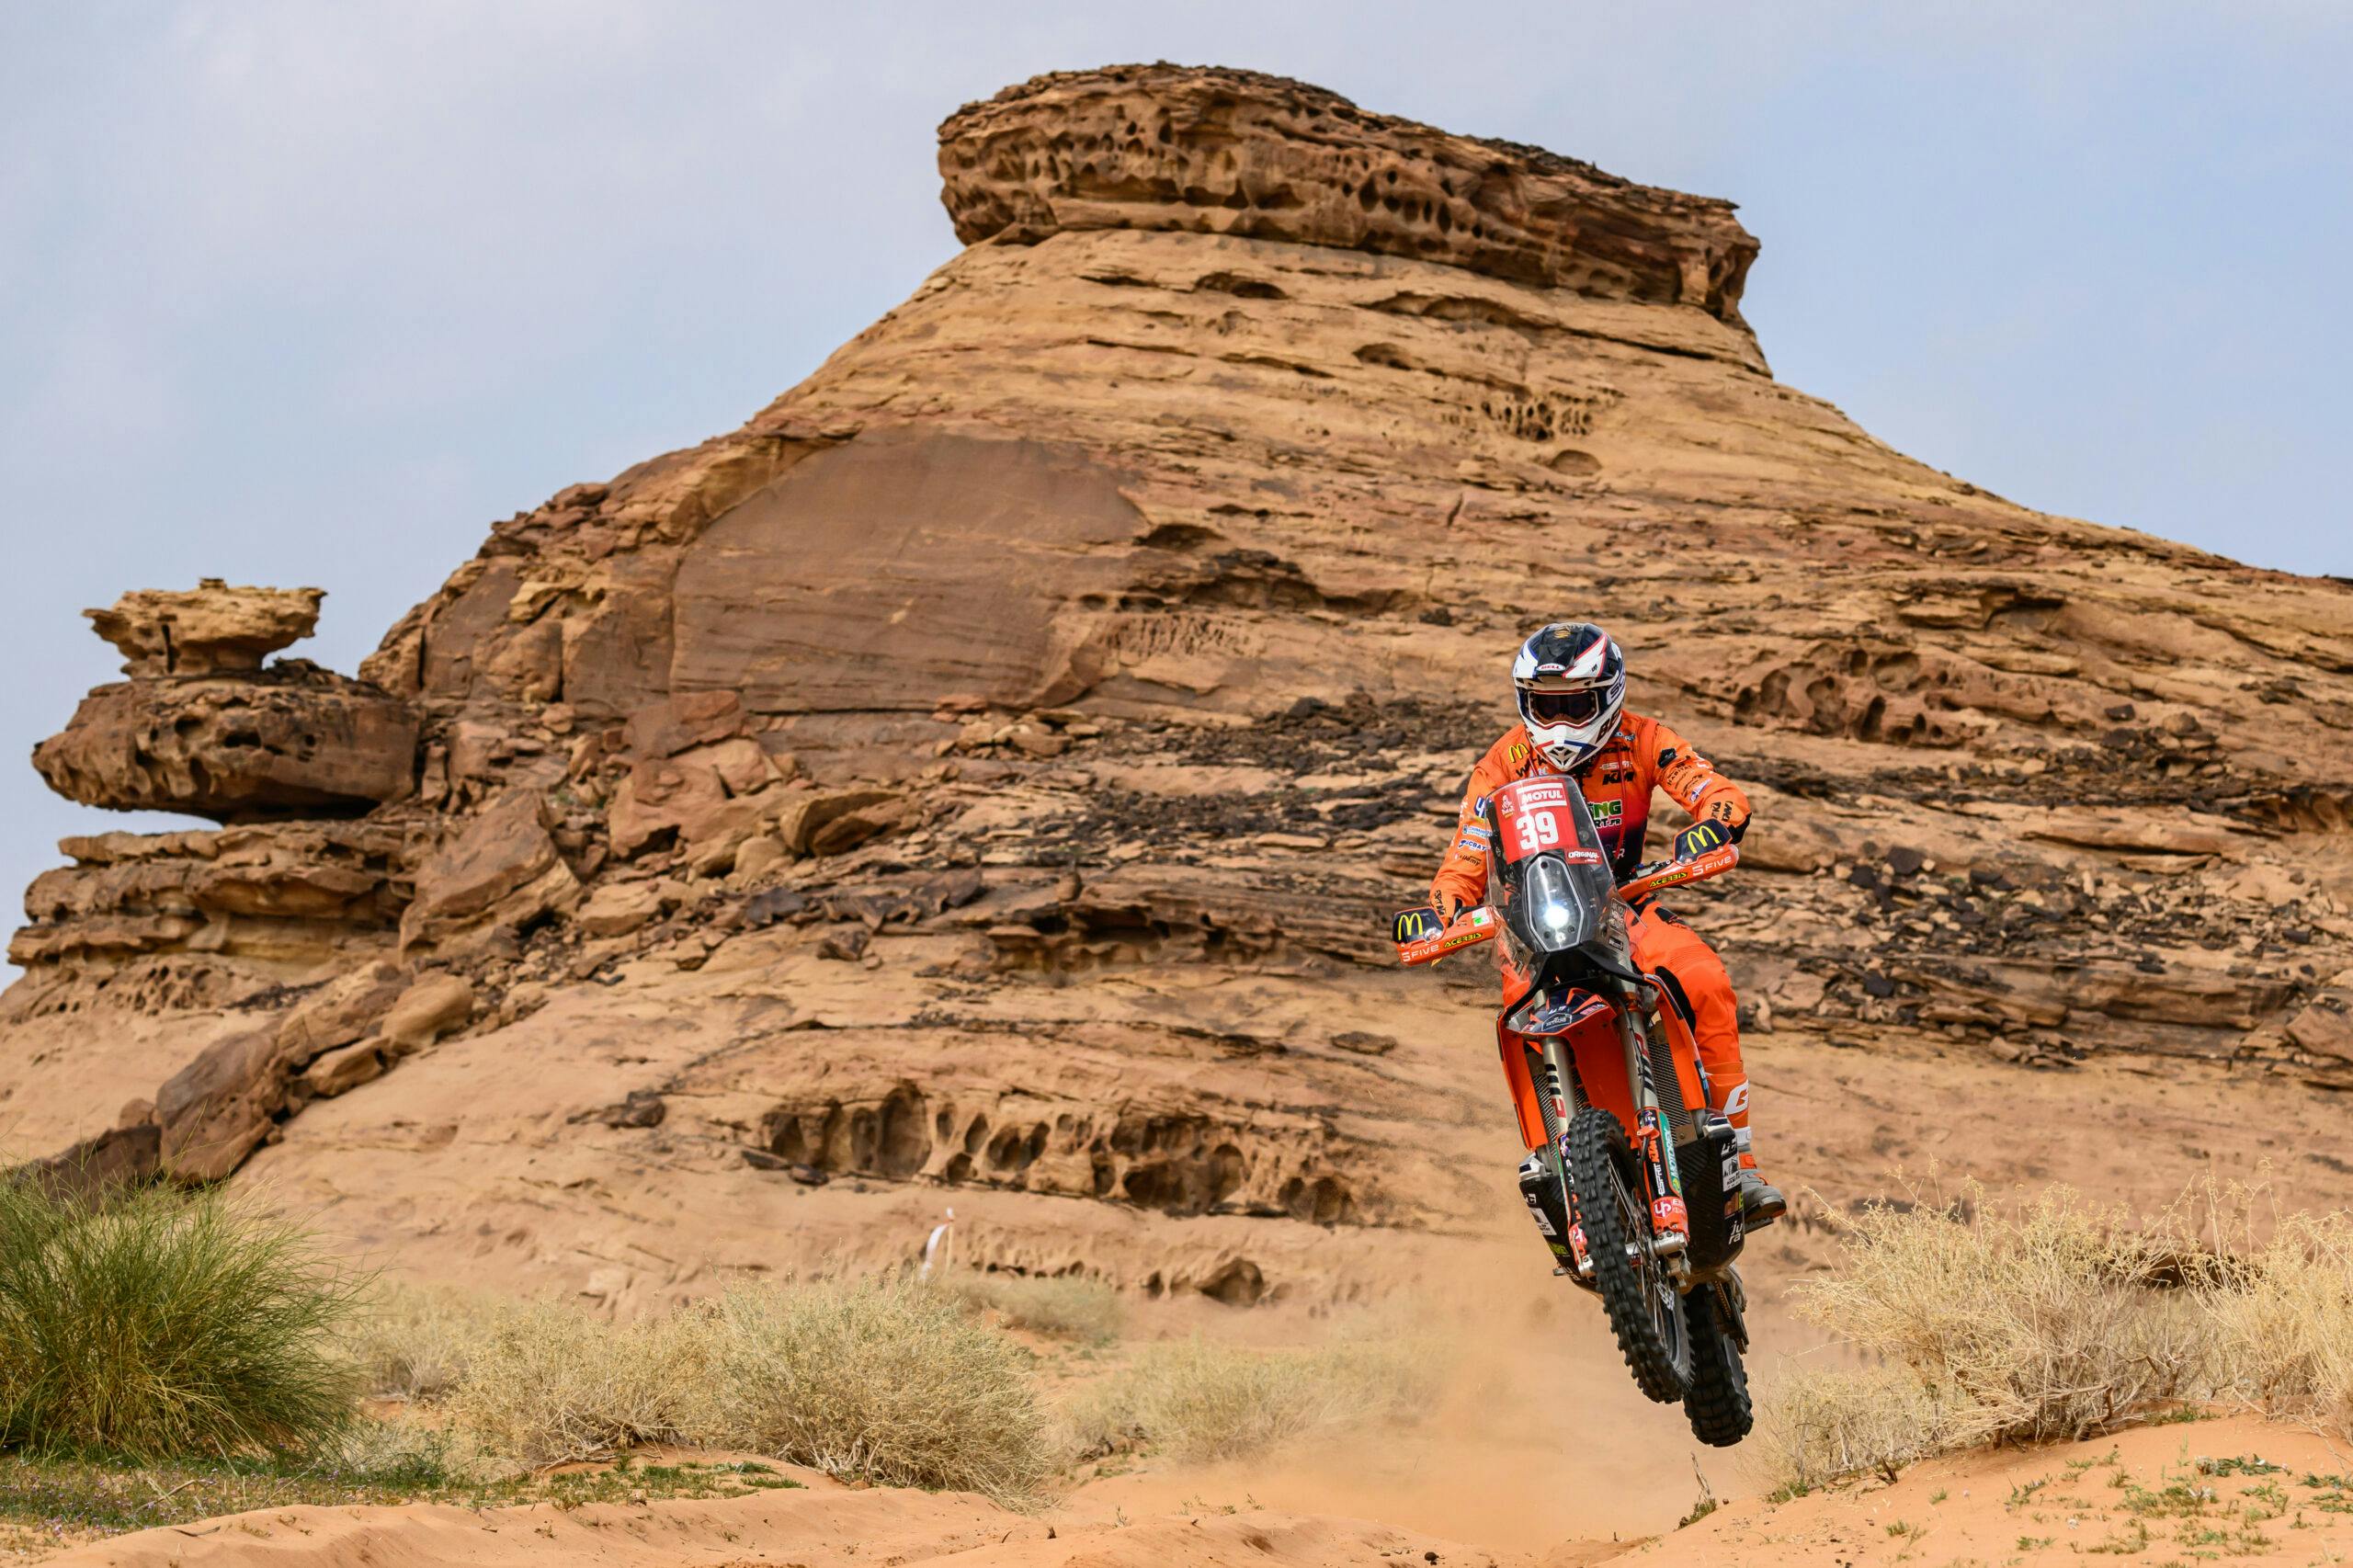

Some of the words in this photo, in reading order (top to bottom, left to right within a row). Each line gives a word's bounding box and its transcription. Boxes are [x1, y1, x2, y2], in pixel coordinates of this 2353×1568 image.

[1521, 790, 1563, 805] MOTUL
[1517, 811, 1559, 850] 39
[1705, 855, 1733, 871] FIVE
[1650, 872, 1688, 888] ACERBIS
[1444, 933, 1483, 948] ACERBIS
[1411, 944, 1439, 958] FIVE
[1664, 1126, 1679, 1178] MOTOREX
